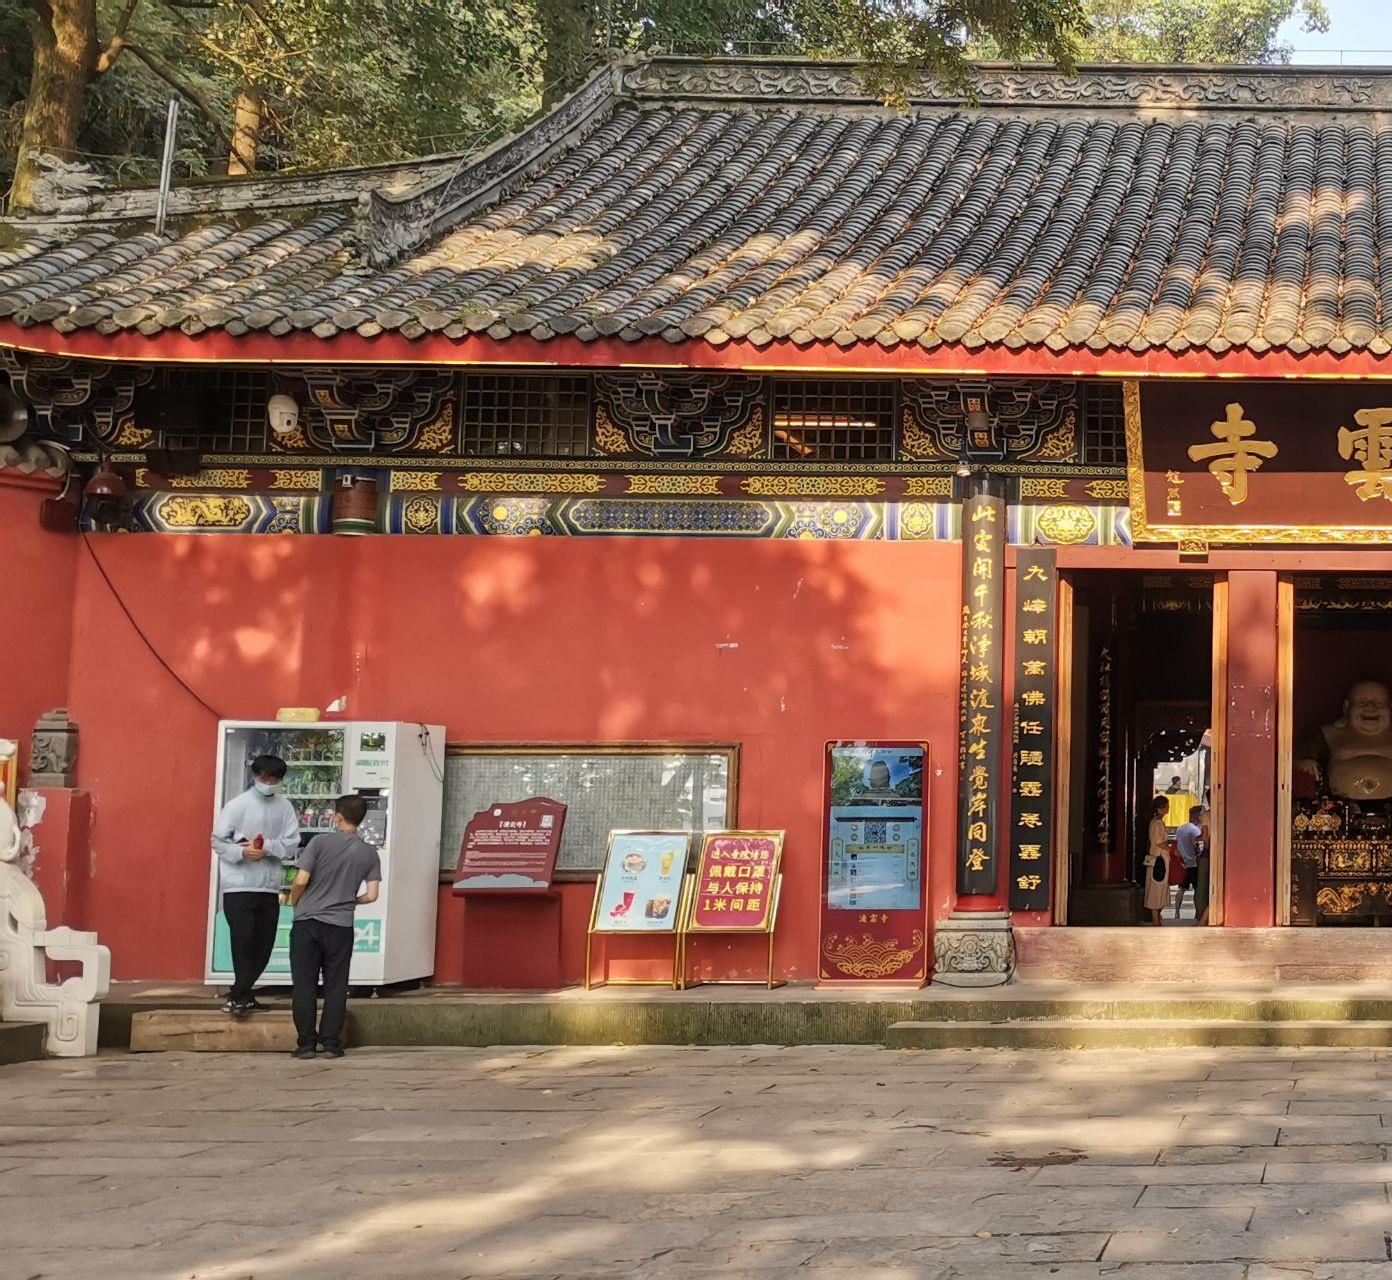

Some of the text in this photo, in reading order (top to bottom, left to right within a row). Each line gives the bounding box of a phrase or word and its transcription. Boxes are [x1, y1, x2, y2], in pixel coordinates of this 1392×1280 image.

[709, 865, 766, 878] 佩戴口罩
[706, 881, 764, 895] 与人保持
[703, 898, 761, 912] 1米间距
